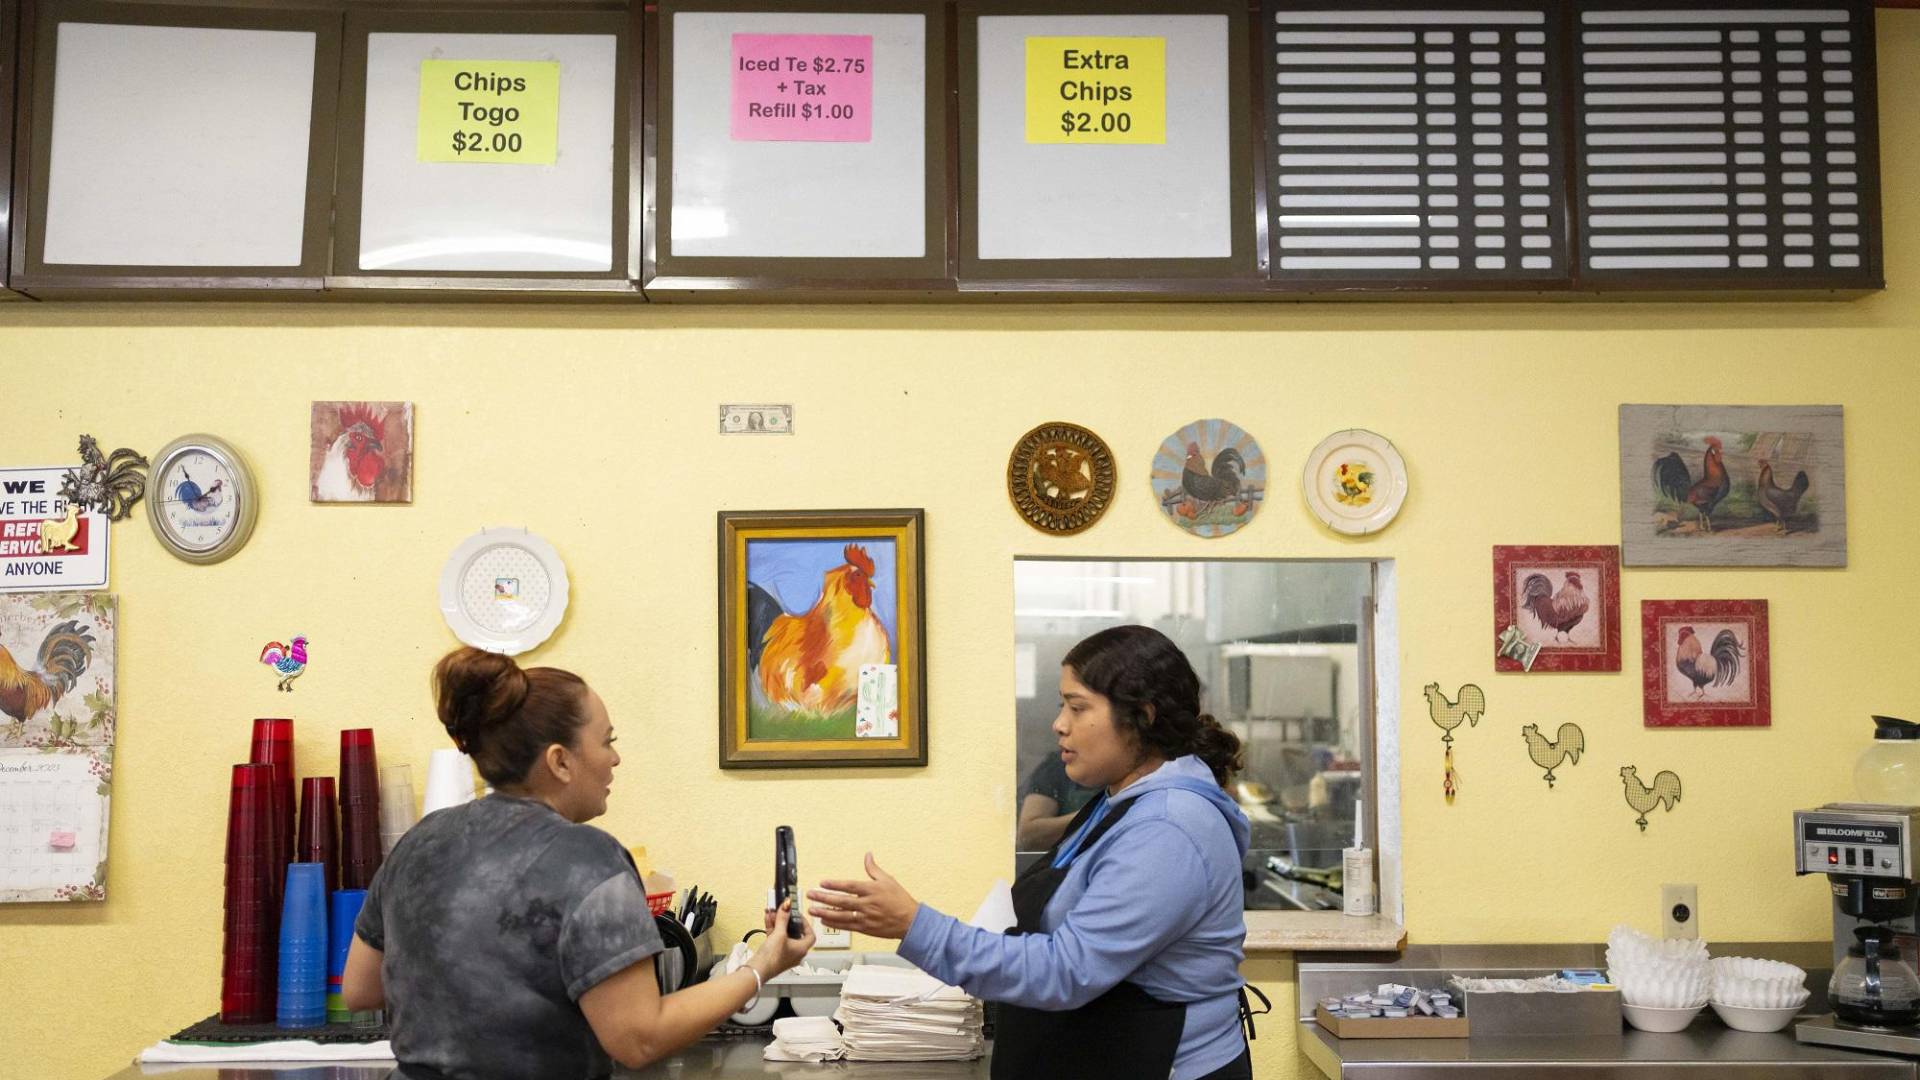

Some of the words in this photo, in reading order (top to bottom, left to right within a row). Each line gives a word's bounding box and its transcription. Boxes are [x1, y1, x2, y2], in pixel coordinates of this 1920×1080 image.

[740, 56, 780, 71] Iced
[785, 57, 807, 72] Te
[813, 56, 865, 75] $2.75
[1063, 49, 1129, 70] Extra
[454, 71, 526, 96] Chips
[777, 82, 788, 93] +
[794, 80, 826, 95] Tax
[1060, 80, 1132, 106] Chips
[458, 102, 519, 126] Togo
[749, 103, 796, 118] Refill
[801, 102, 853, 121] $1.00
[1061, 110, 1131, 136] $2.00
[452, 130, 522, 155] $2.00
[193, 455, 204, 465] 12
[3, 480, 45, 494] WE
[21, 500, 47, 514] THE
[5, 561, 63, 575] ANYONE
[1827, 828, 1885, 838] BLOOMFIELD
